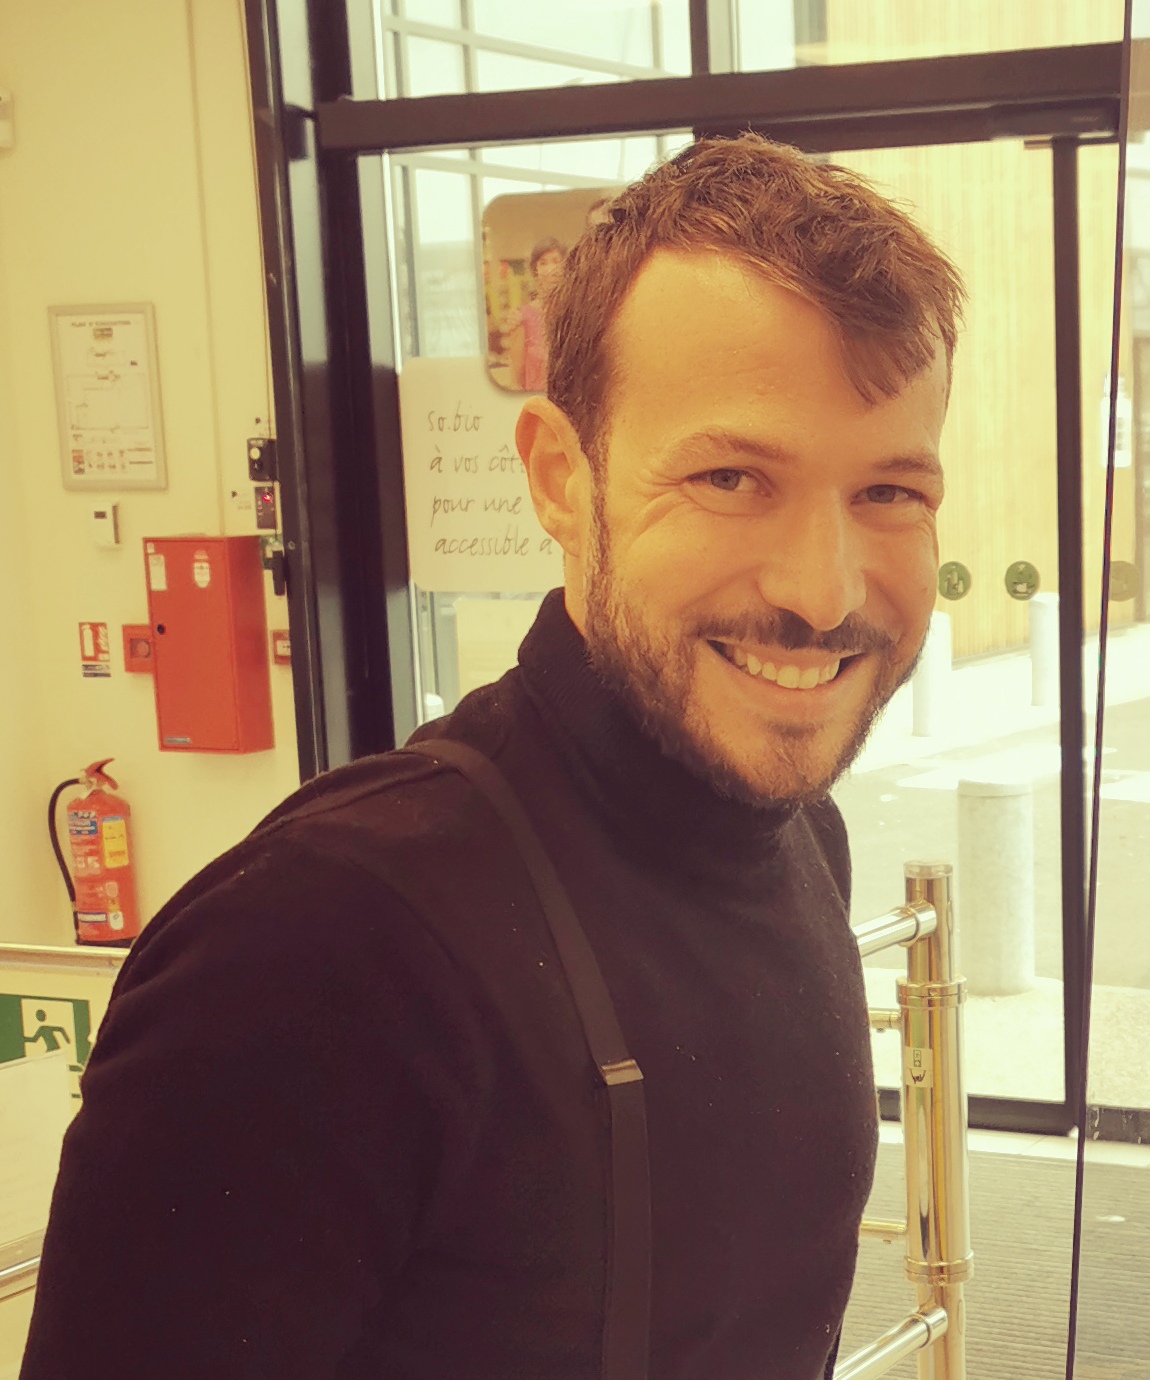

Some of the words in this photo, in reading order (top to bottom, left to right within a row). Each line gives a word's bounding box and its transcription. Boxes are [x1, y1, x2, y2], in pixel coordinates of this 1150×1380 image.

[454, 455, 479, 474] vos
[430, 496, 475, 528] pour
[484, 496, 522, 515] une
[434, 523, 530, 556] accessible
